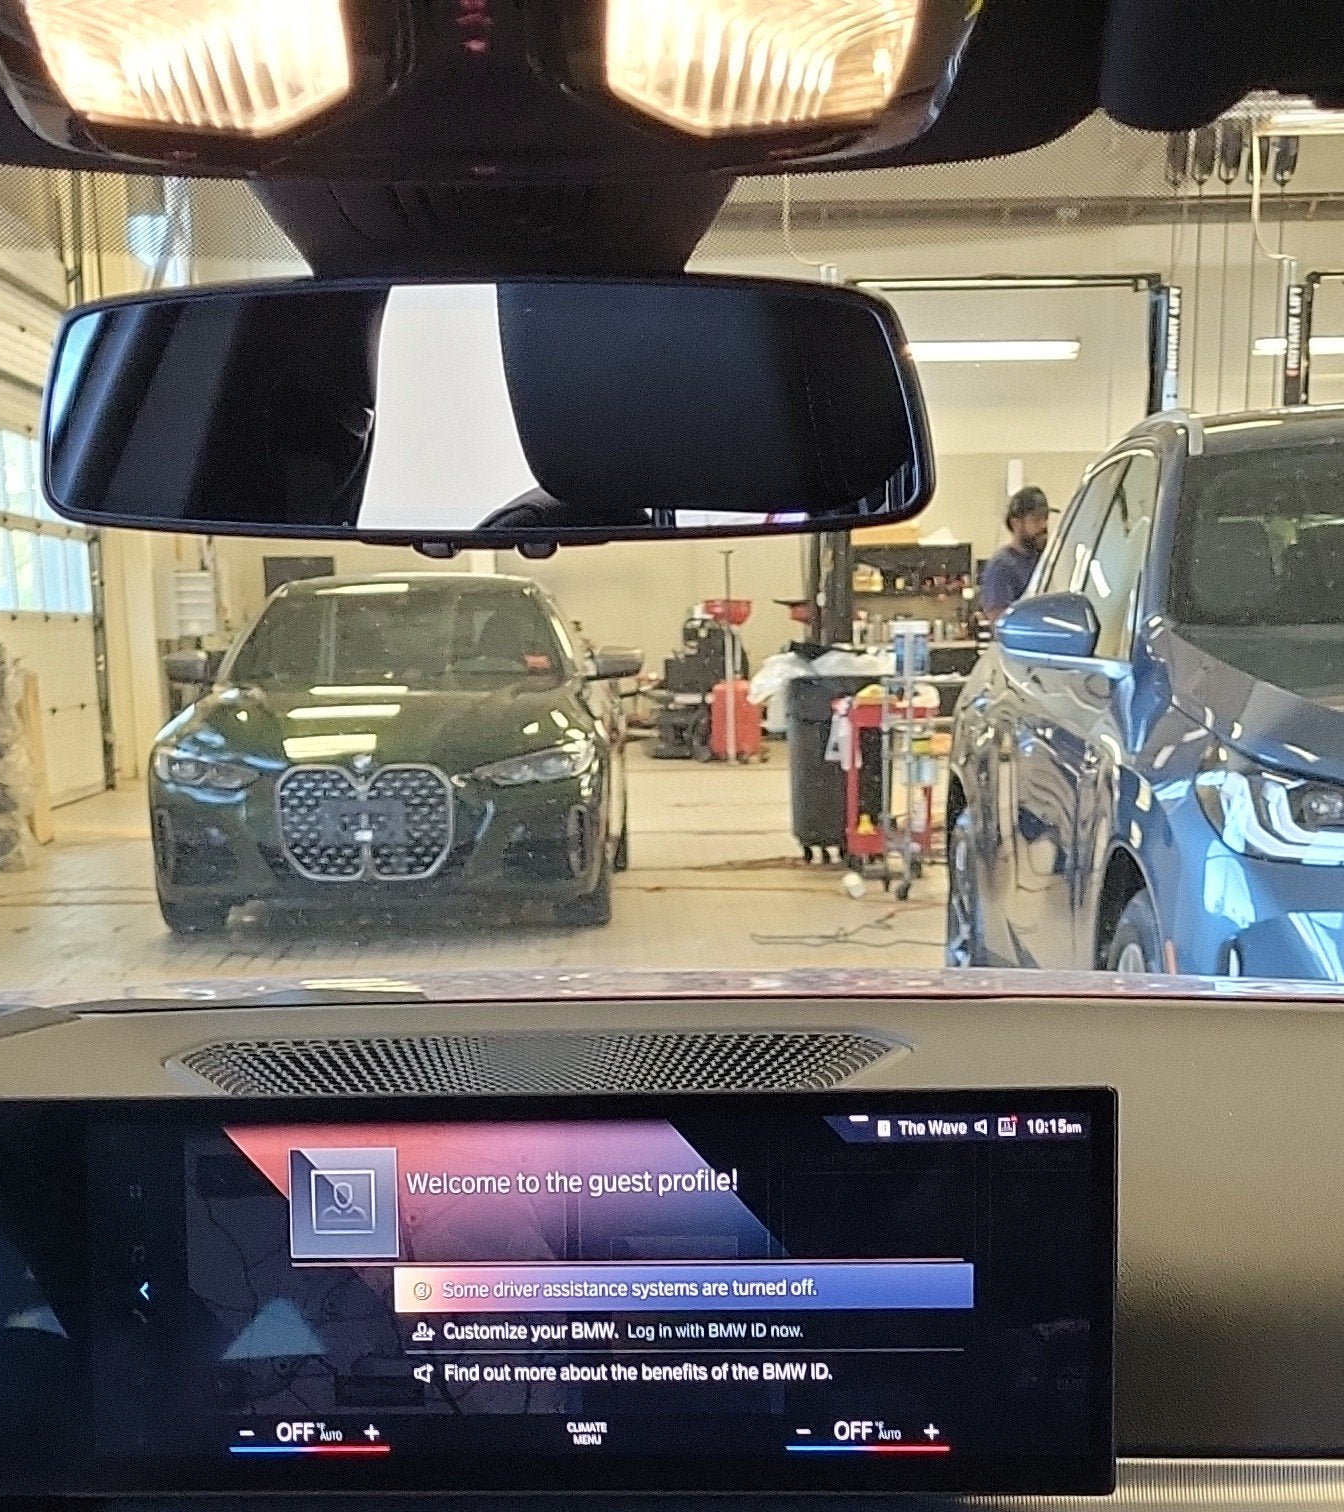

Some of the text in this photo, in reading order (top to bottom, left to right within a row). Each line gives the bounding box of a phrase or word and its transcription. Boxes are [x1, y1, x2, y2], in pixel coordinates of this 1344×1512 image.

[897, 1119, 968, 1136] The Wave
[406, 1168, 739, 1198] Welcome to the guest profile!
[442, 1278, 818, 1301] Some driver assistance systems are turned off.
[442, 1321, 804, 1344] Customize your BMW. Log in with BMW ID now.
[443, 1362, 833, 1382] Find out more about the benefits of the BMW ID.
[276, 1421, 315, 1442] OFF
[566, 1421, 608, 1434] CLIMATE
[833, 1420, 874, 1441] OFF
[572, 1434, 602, 1446] MENU
